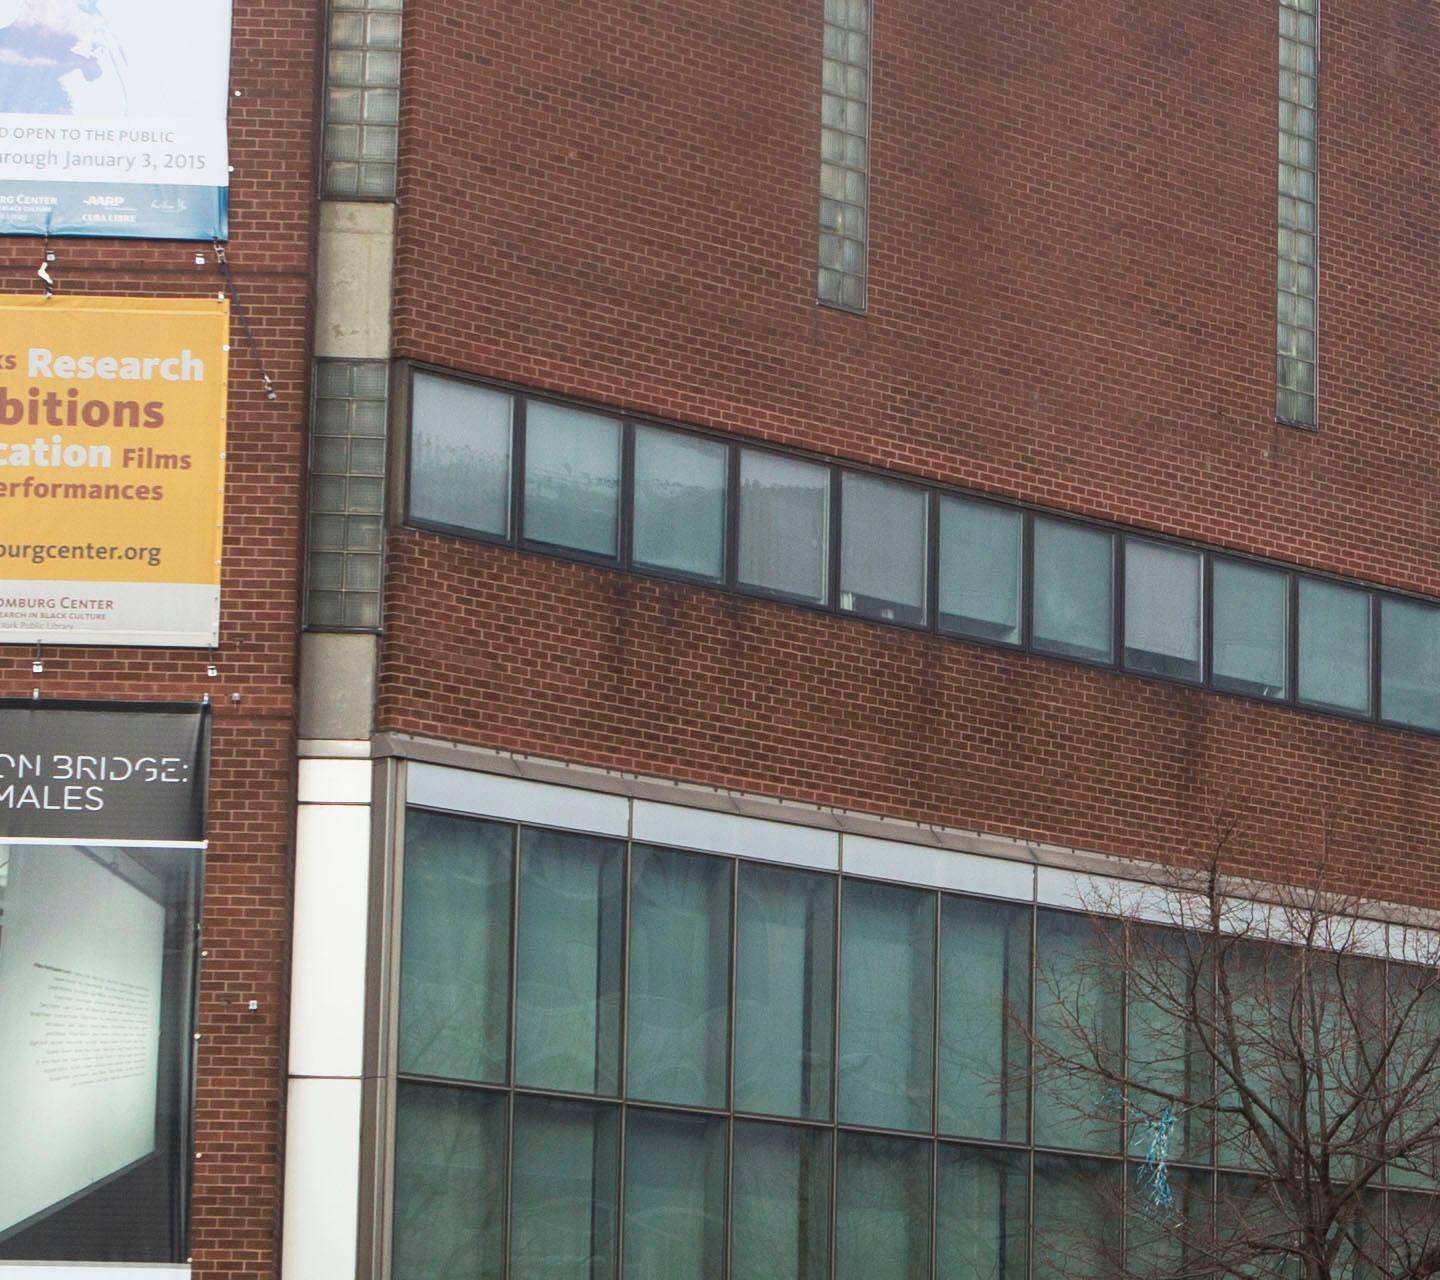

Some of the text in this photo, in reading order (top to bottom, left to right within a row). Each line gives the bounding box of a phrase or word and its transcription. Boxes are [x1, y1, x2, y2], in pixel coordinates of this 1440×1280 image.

[13, 127, 56, 141] OPEN
[60, 128, 81, 142] TO
[85, 128, 115, 143] THE
[119, 130, 175, 144] PUBLIC
[63, 150, 136, 172] January
[141, 152, 159, 172] 3,
[163, 153, 206, 170] 2015
[16, 194, 58, 207] CENTER
[28, 348, 204, 381] Research
[122, 448, 192, 470] Films
[60, 596, 114, 610] CENTER
[20, 621, 44, 629] Public
[46, 622, 73, 631] Library
[53, 754, 189, 783] BRIDGE:
